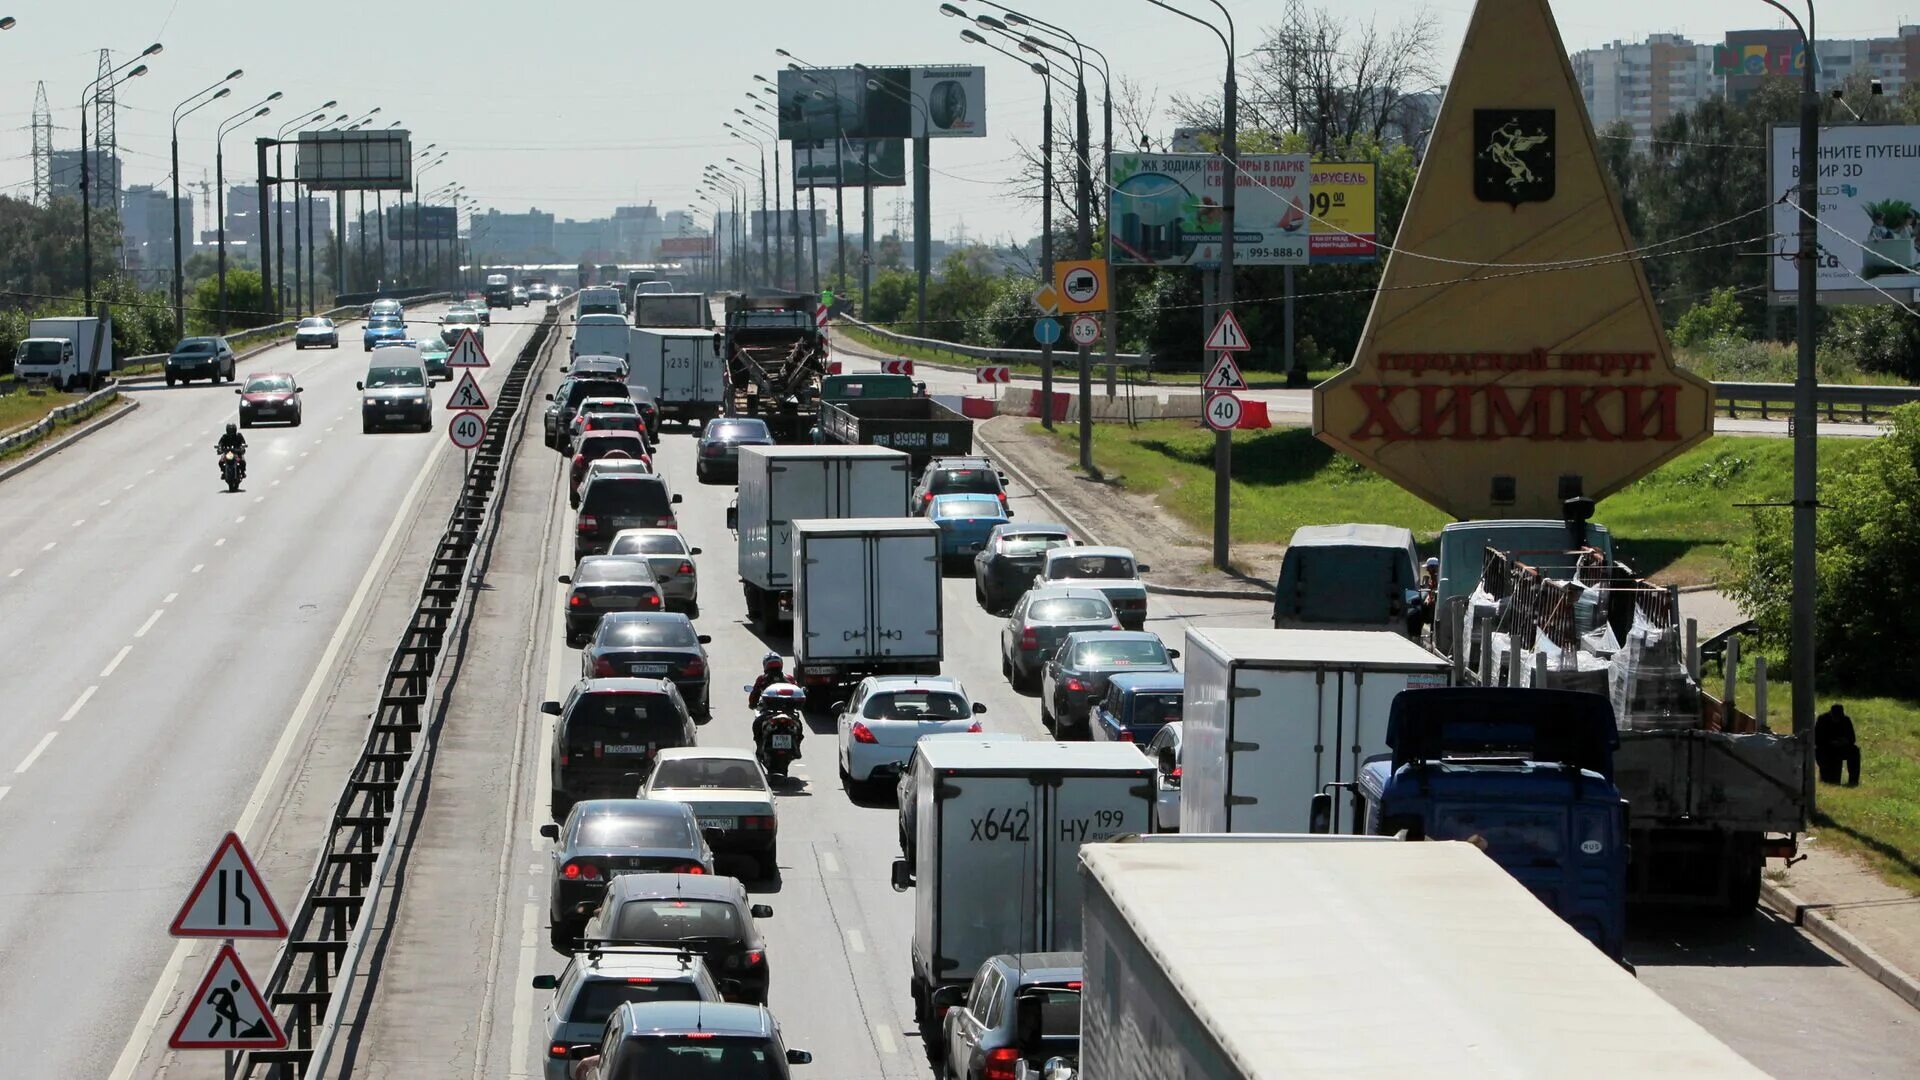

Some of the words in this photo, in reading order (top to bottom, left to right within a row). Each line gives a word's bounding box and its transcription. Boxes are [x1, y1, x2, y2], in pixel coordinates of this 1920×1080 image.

[1866, 144, 1920, 159] ПУТЕШ
[1141, 159, 1158, 172] ЖК
[1162, 159, 1202, 172] ЗОДИАК
[1264, 160, 1270, 171] В
[1273, 159, 1305, 173] ПАРКЕ
[1843, 163, 1863, 177] 3D
[1207, 175, 1213, 187] С
[1270, 175, 1296, 188] ВОДУ
[1310, 171, 1367, 185] АРУСЕЛЬ
[1333, 191, 1344, 202] 00
[1249, 247, 1303, 258] 995-888-0
[1817, 255, 1839, 268] LG
[1214, 402, 1234, 419] 40
[1350, 383, 1683, 441] ХИМКИ
[458, 421, 477, 437] 40
[1094, 809, 1124, 828] 199
[1583, 843, 1600, 851] RUS
